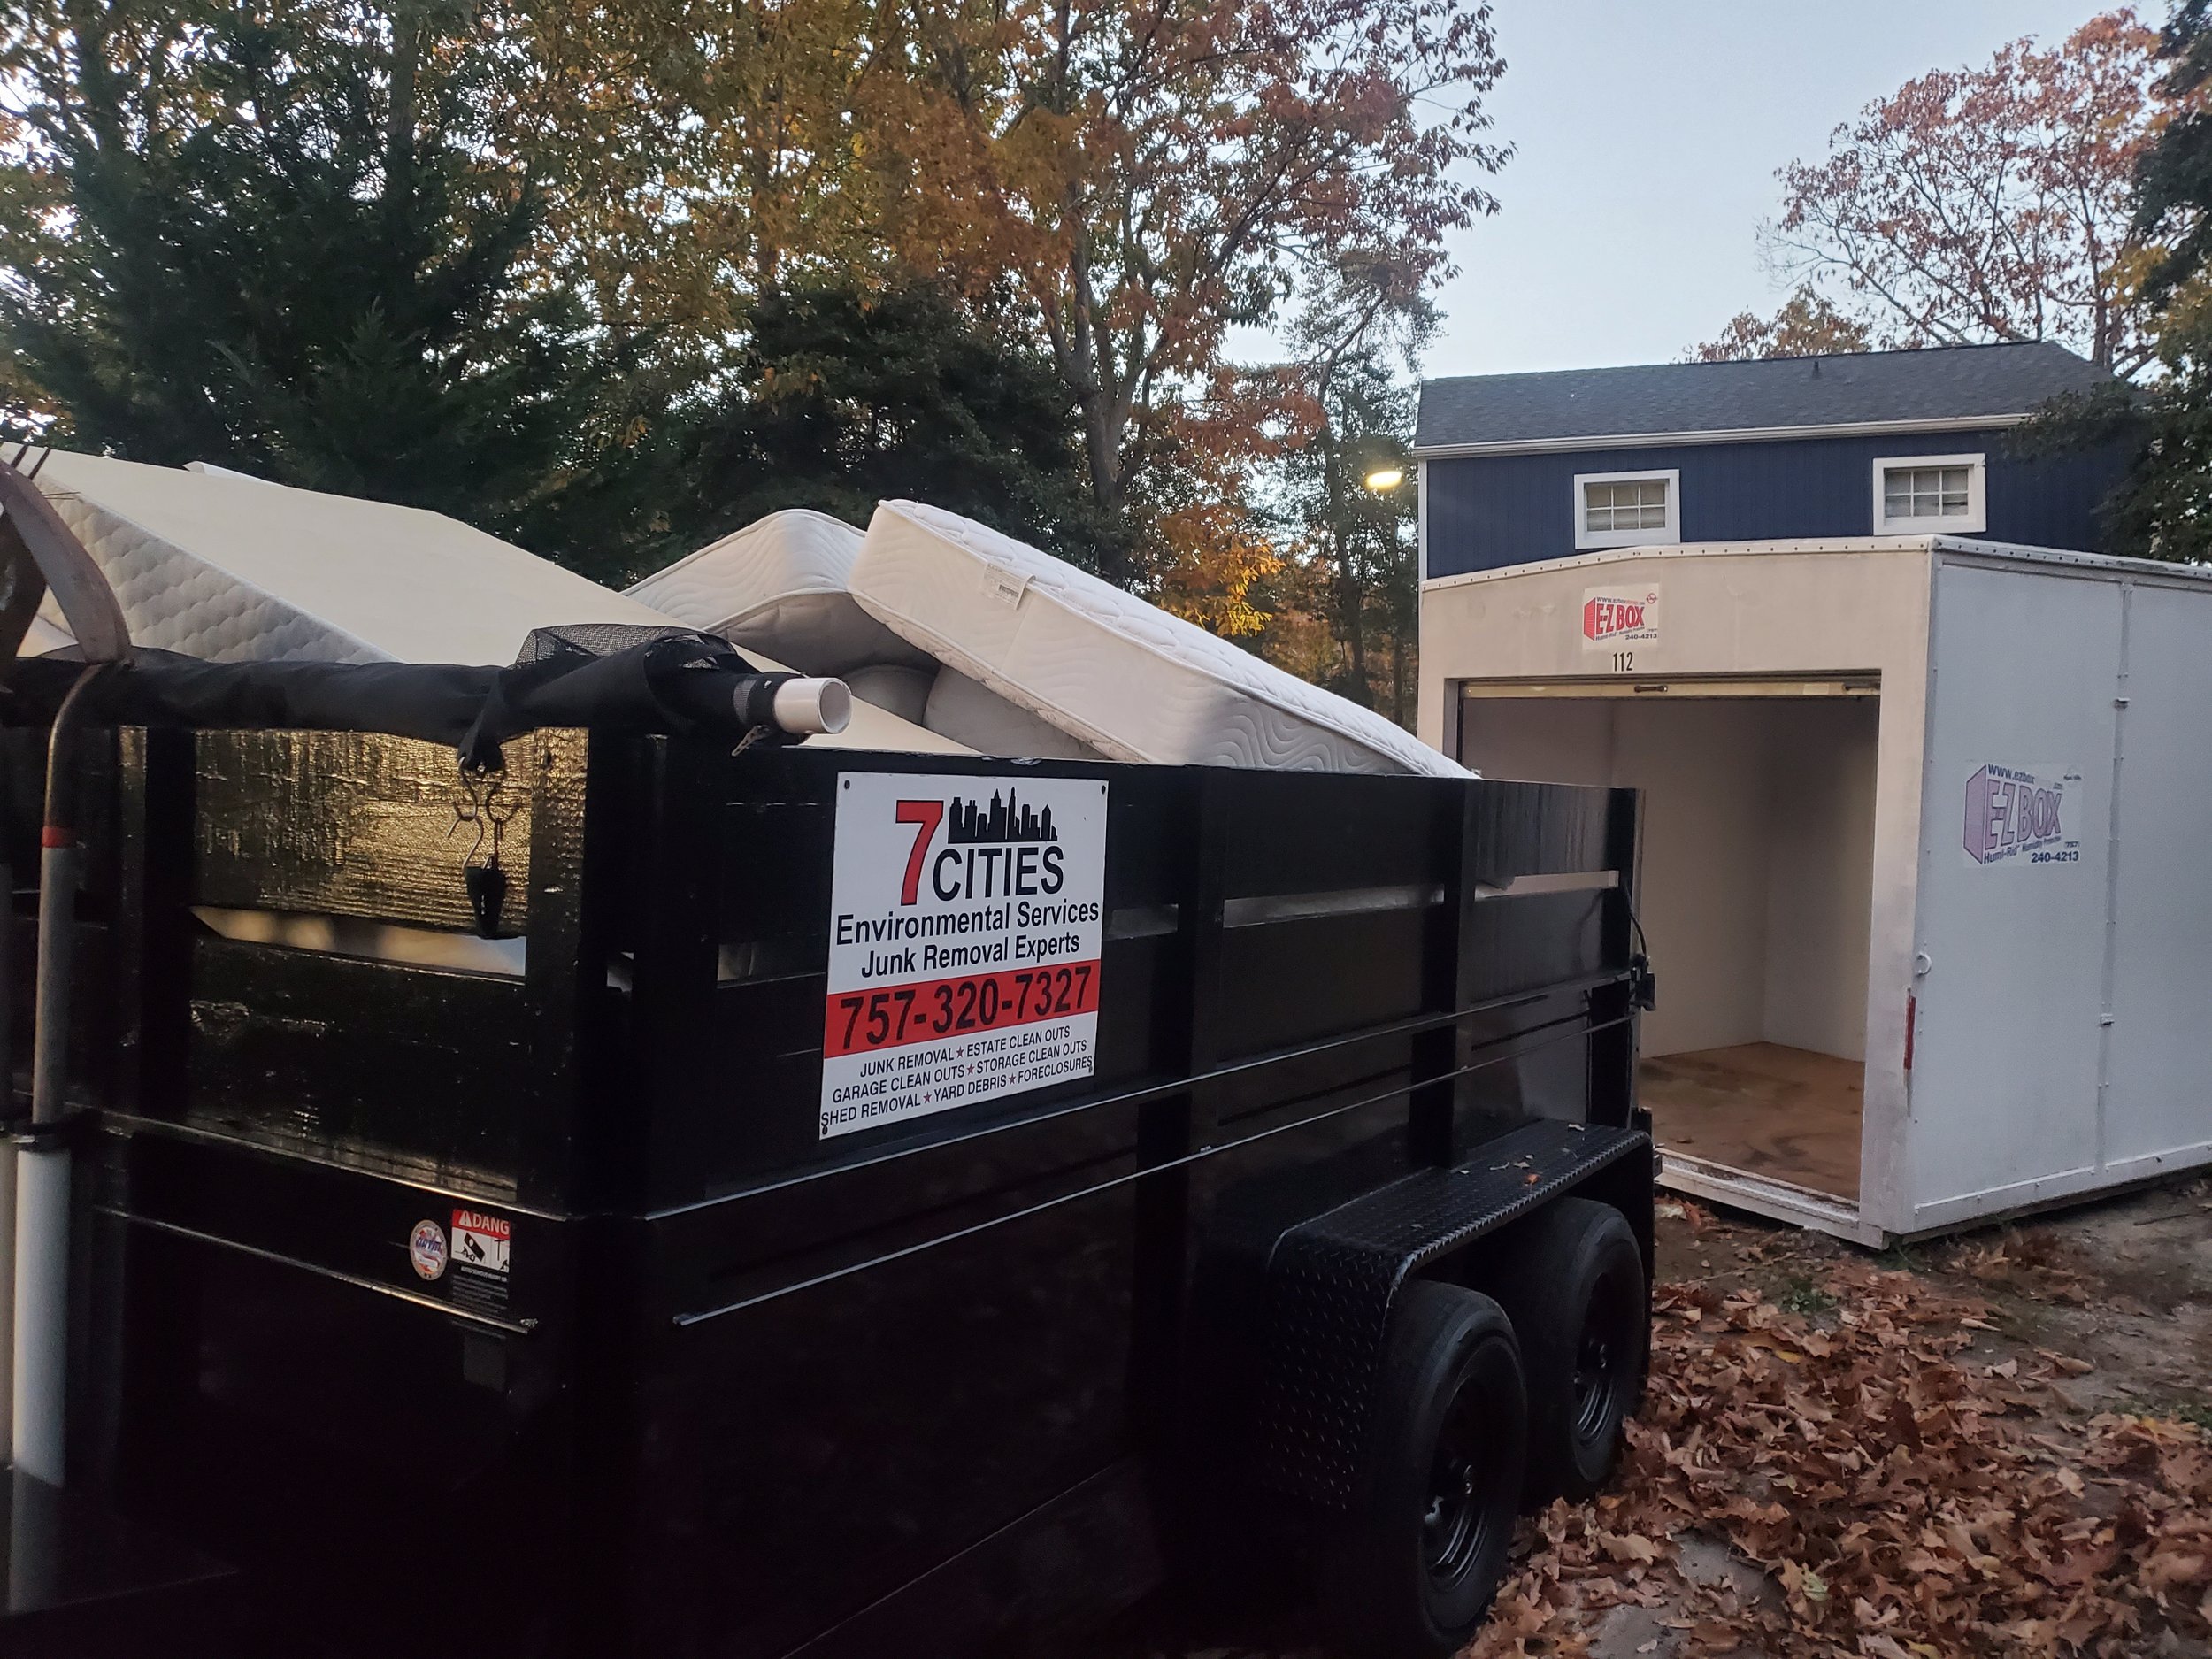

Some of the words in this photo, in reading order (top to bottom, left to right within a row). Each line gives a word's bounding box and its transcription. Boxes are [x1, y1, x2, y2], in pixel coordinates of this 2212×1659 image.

[1596, 603, 1615, 634] E-Z
[1616, 605, 1645, 631] BOX
[1613, 651, 1633, 672] 112
[1985, 779, 2016, 850] E-Z
[2017, 785, 2062, 843] BOX
[895, 799, 944, 906] 7
[932, 846, 1064, 902] CITIES
[2031, 851, 2079, 864] 240-4213
[836, 902, 1010, 945] Environmental
[1018, 898, 1099, 928] Services
[861, 949, 917, 979] Junk
[924, 937, 1008, 971] Removal
[1015, 932, 1080, 964] Experts
[841, 966, 1091, 1050] 757-320-7327
[833, 1078, 887, 1103] GARAGE
[890, 1069, 930, 1092] CLEAN
[933, 1065, 965, 1085] OUTS
[976, 1052, 1026, 1074] STORAGE
[1028, 1045, 1060, 1064] CLEAN
[1062, 1040, 1087, 1056] OUTS
[860, 1058, 895, 1078] JUNK
[897, 1048, 954, 1071] REMOVAL
[966, 1039, 1007, 1057] ESTATE
[1009, 1030, 1042, 1049] CLEAN
[1044, 1025, 1070, 1041] OUTS
[820, 1106, 857, 1128] SHED
[861, 1093, 921, 1119] REMOVAL
[933, 1084, 964, 1102] YARD
[967, 1074, 1007, 1094] DEBRIS
[1018, 1055, 1093, 1085] FORECLOSURES
